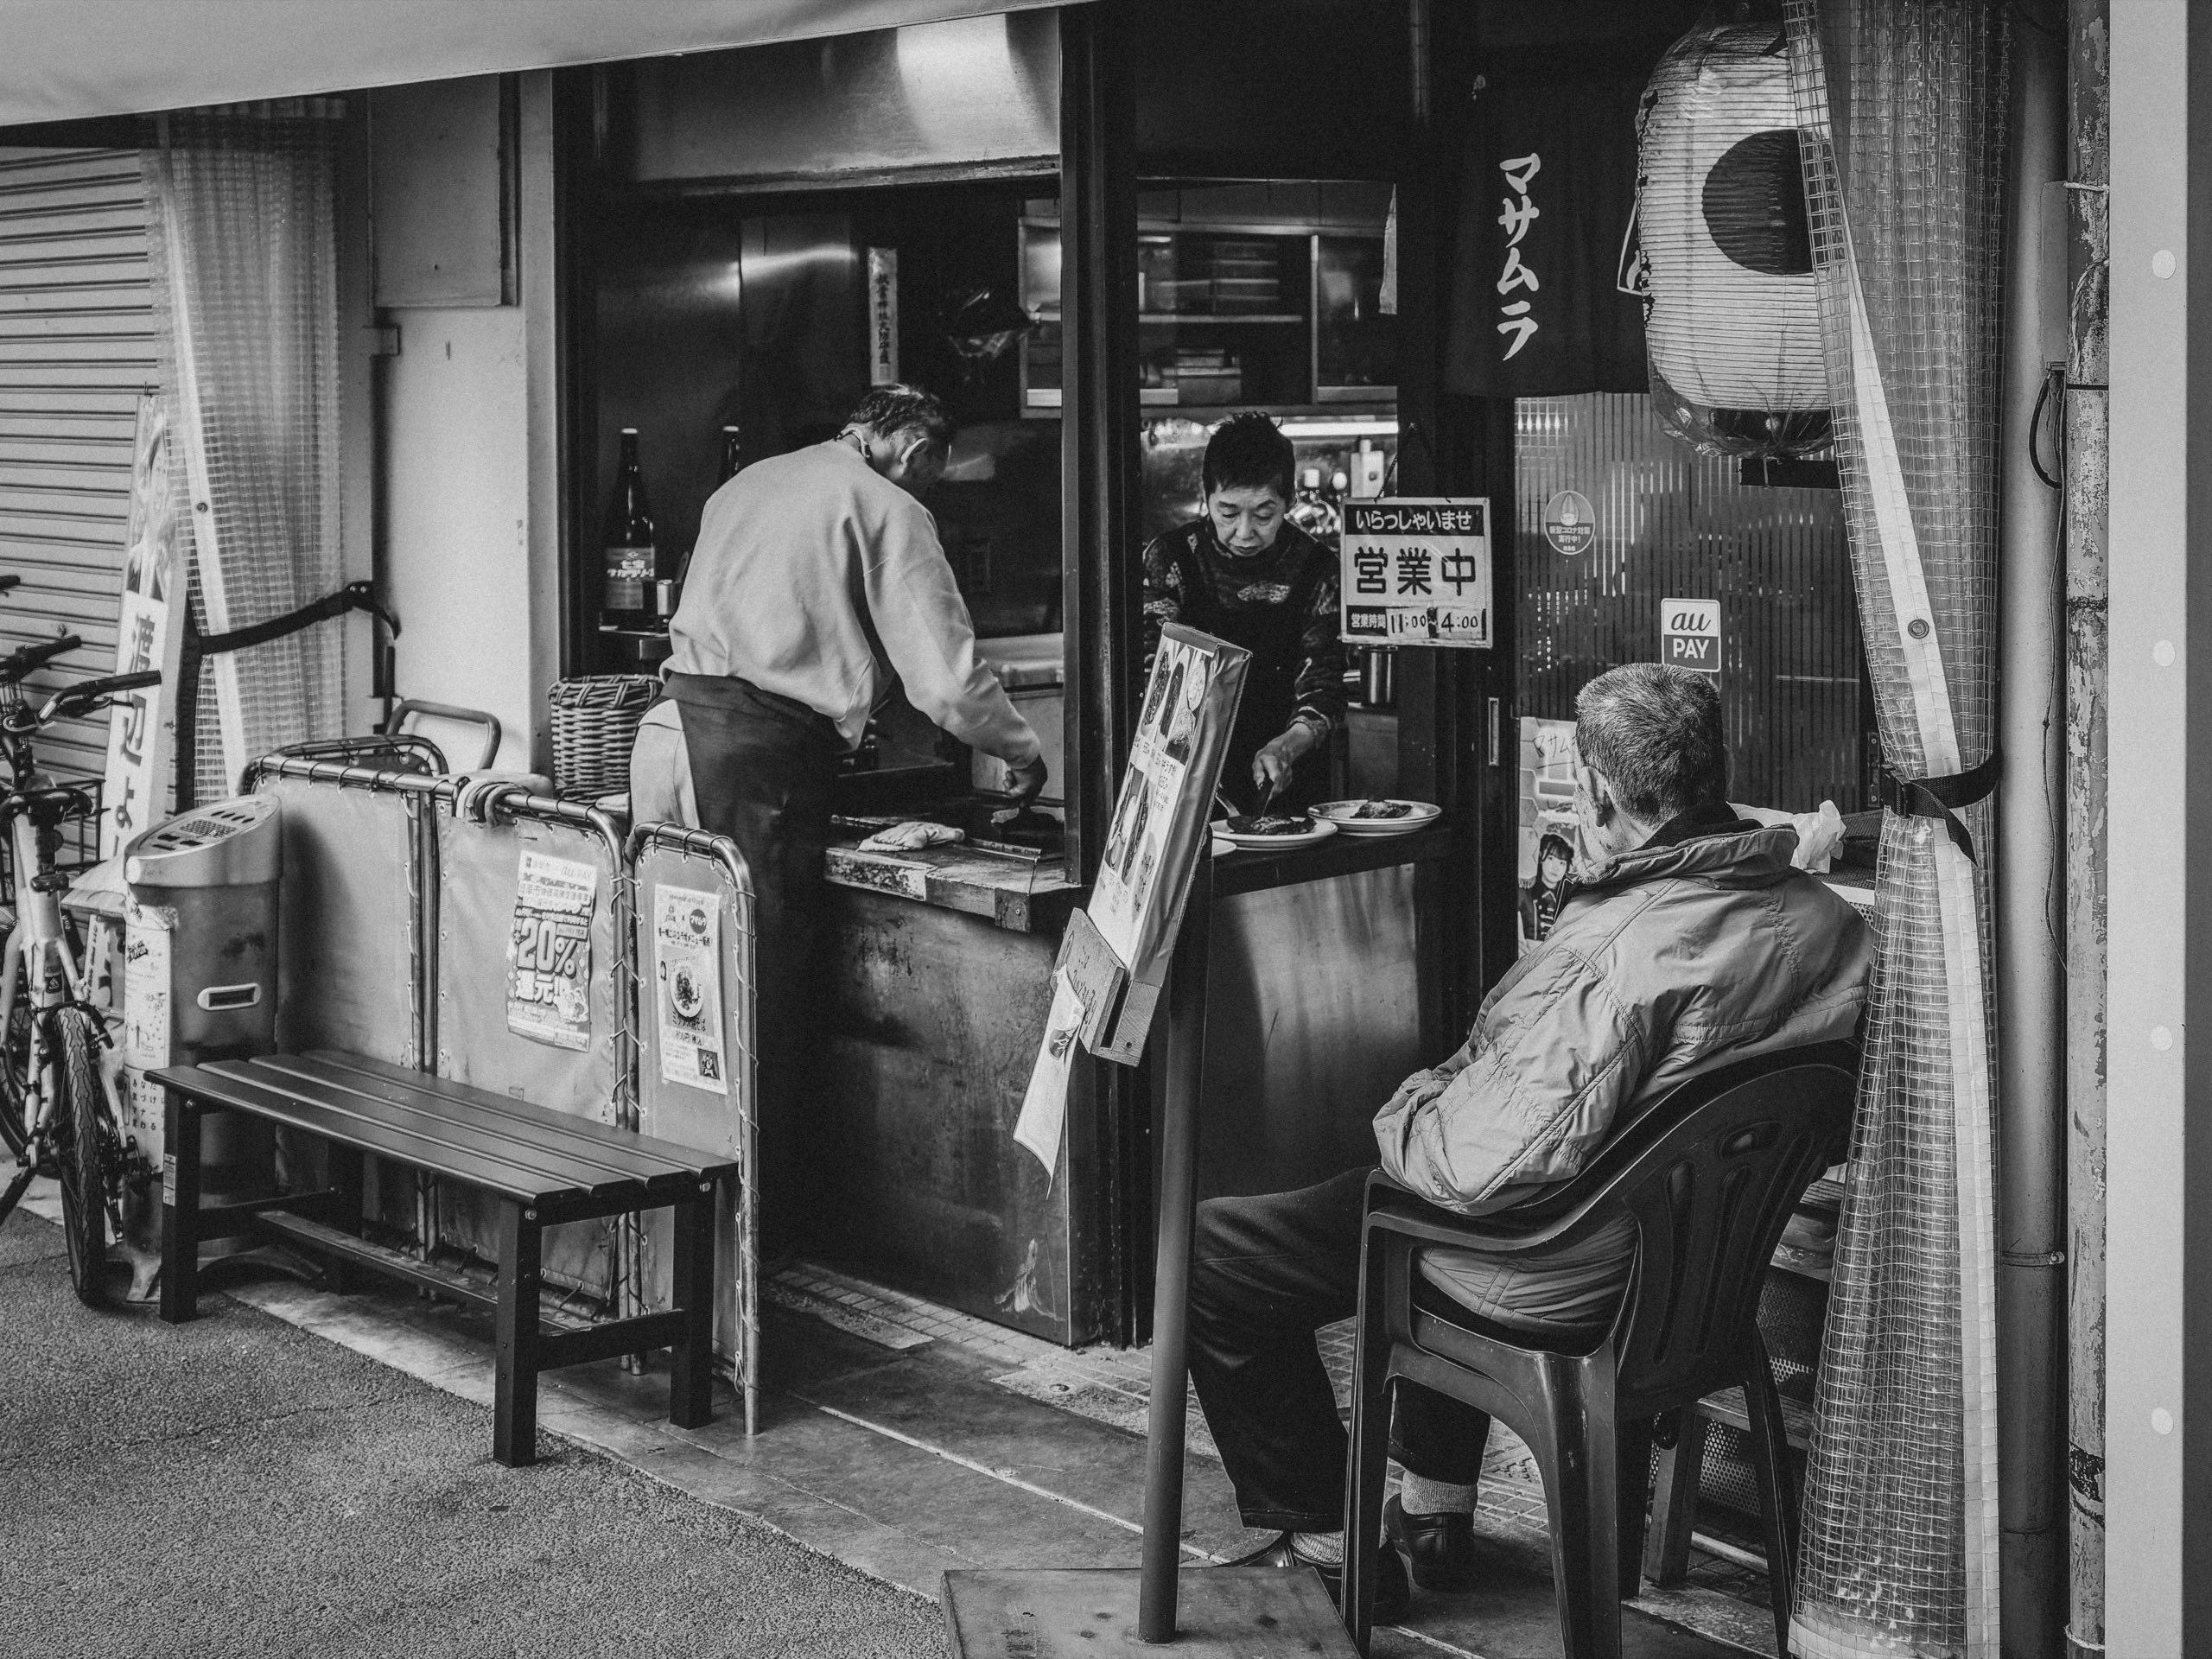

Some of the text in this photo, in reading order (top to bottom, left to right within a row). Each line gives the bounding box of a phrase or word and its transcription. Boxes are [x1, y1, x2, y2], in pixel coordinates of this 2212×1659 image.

[1497, 152, 1541, 361] マサムラ
[1355, 510, 1472, 531] いらっしゃいませ
[1353, 546, 1477, 597] 営業中
[1351, 613, 1387, 629] 営業時間
[1670, 612, 1712, 632] au
[1672, 638, 1710, 659] PAY
[517, 917, 577, 979] 20%
